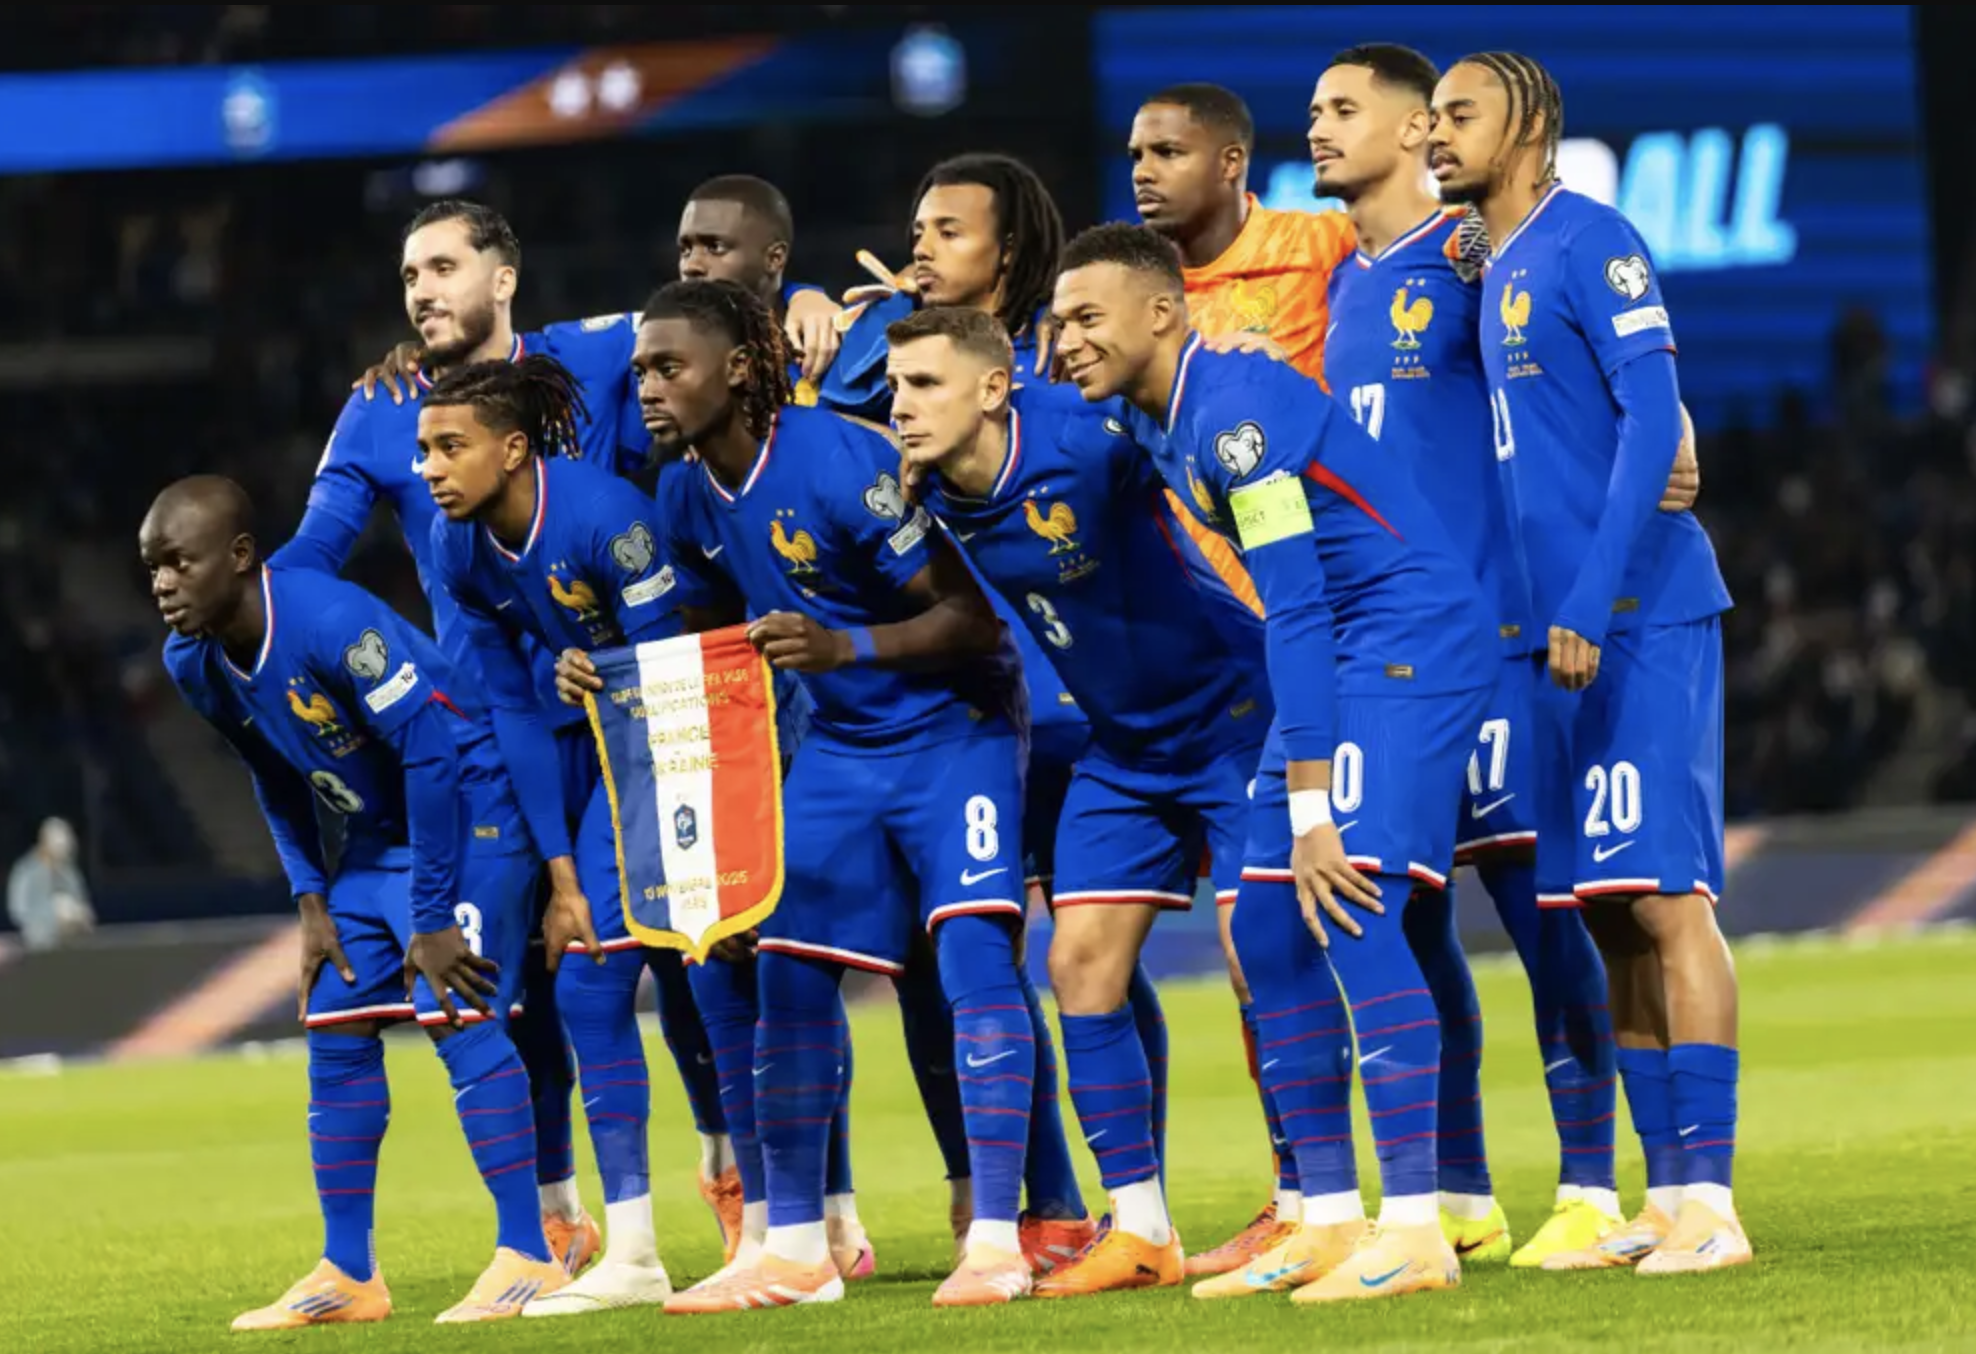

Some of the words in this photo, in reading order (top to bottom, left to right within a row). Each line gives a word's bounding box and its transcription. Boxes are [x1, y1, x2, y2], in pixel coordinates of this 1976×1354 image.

[1026, 592, 1073, 649] 3
[309, 770, 365, 813] 3
[1584, 761, 1642, 838] 20
[965, 794, 999, 861] 8
